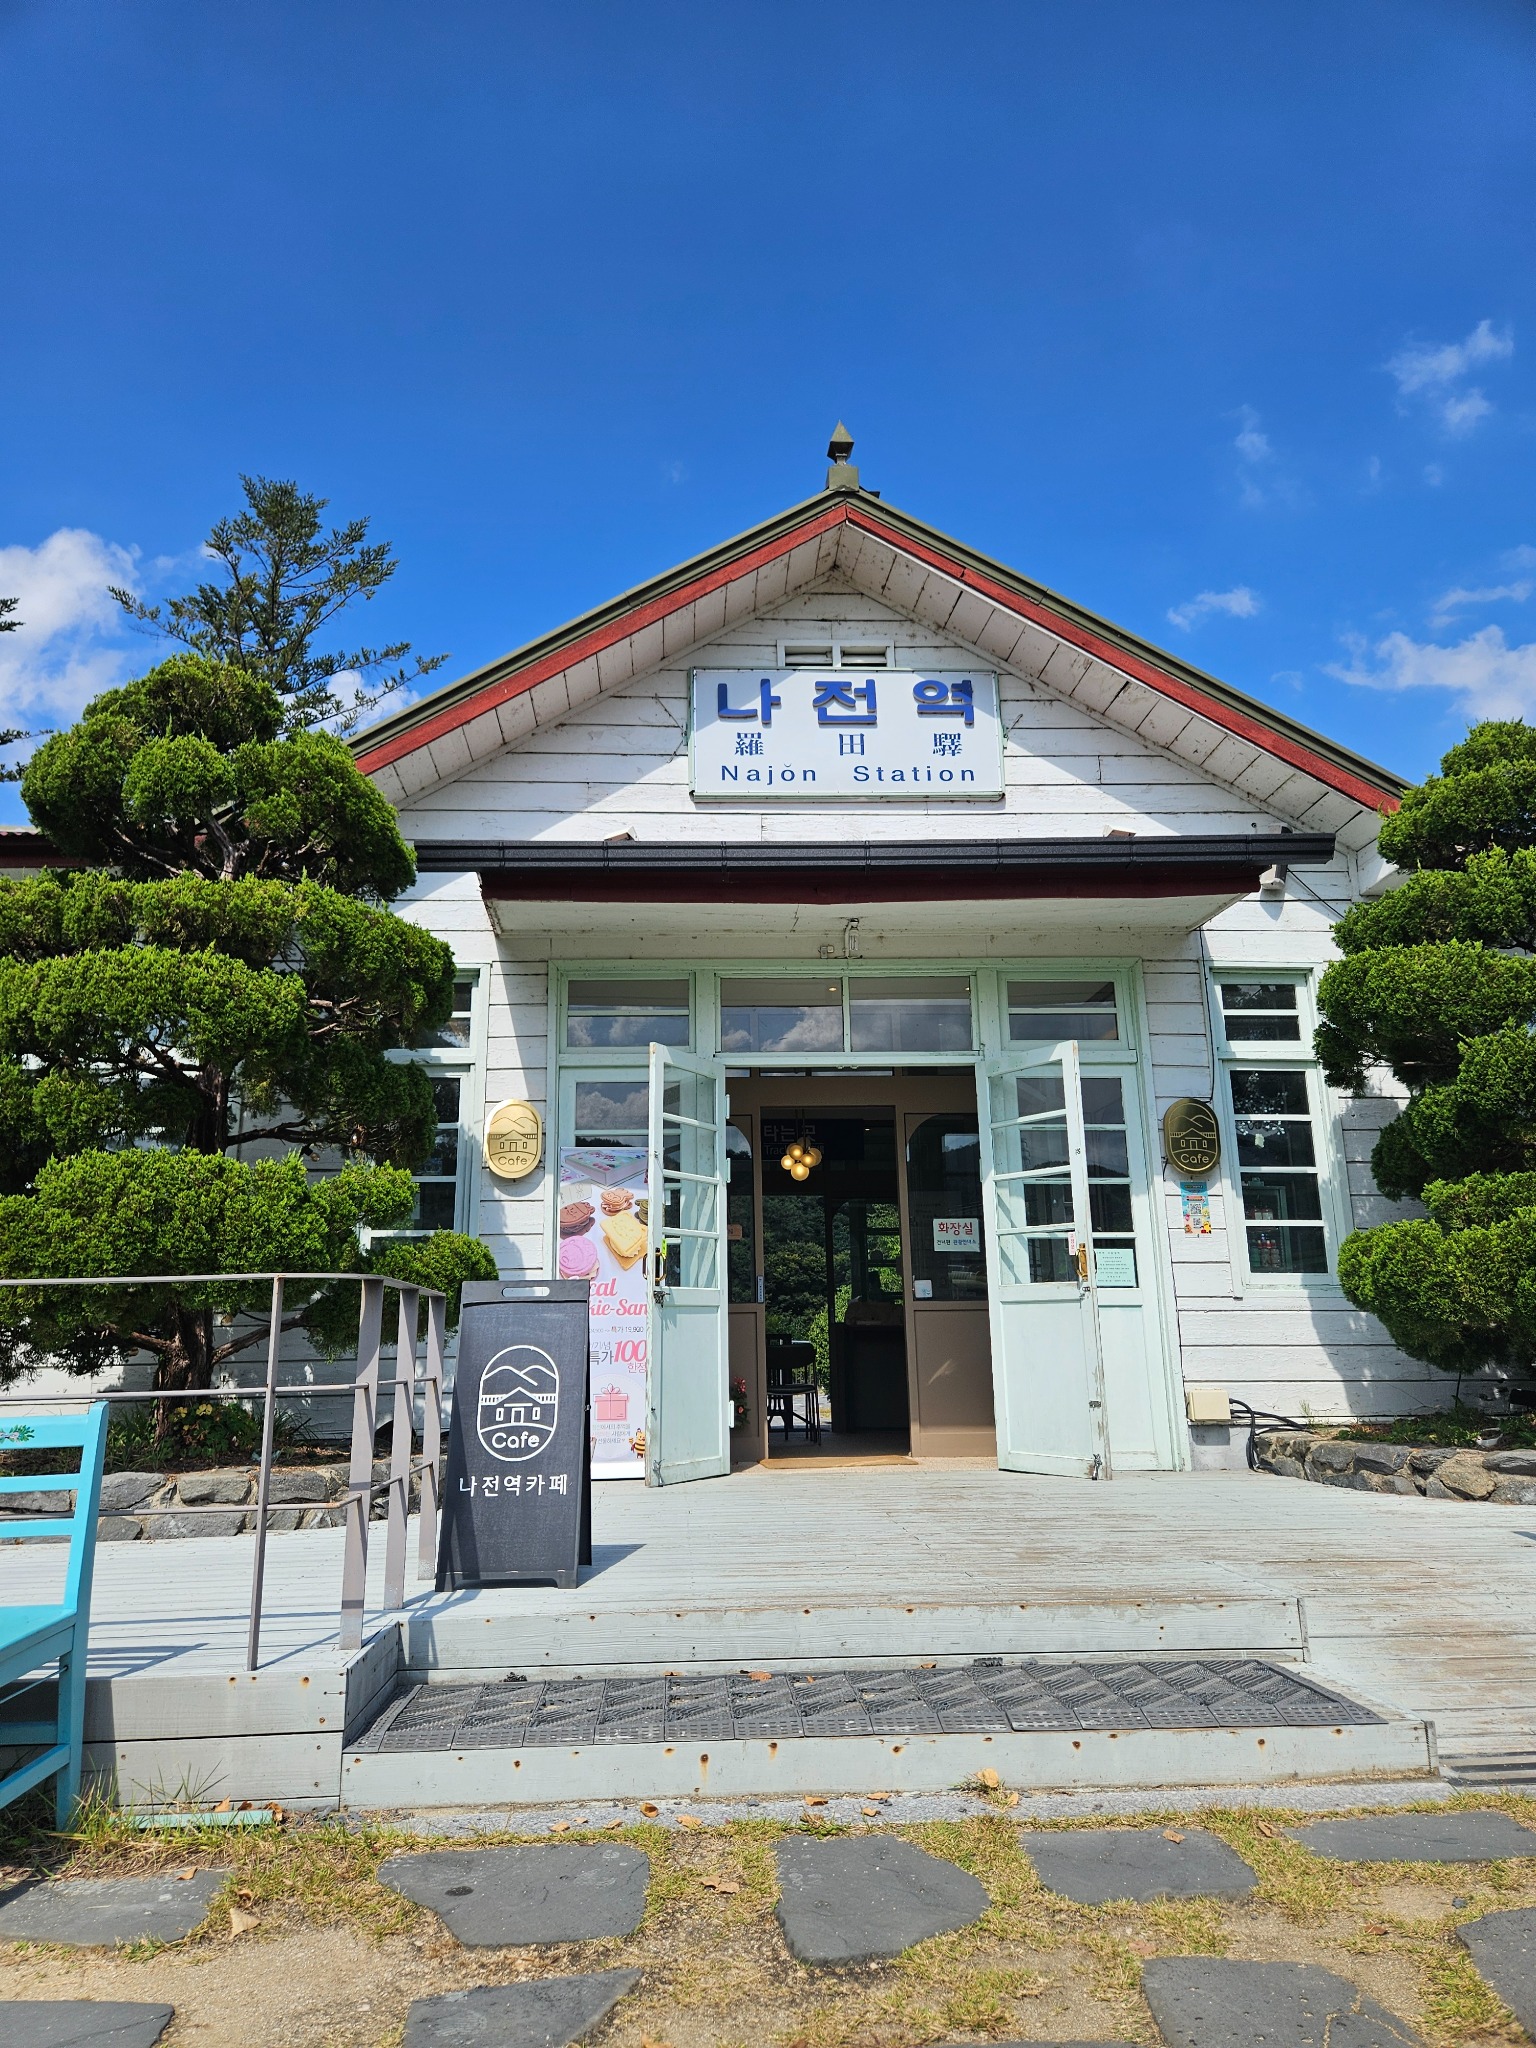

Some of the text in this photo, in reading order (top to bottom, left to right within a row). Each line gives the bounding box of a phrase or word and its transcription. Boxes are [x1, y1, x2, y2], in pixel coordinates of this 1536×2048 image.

[717, 678, 975, 727] 나전역
[735, 732, 962, 757] 羅田驛
[853, 765, 976, 782] Station
[498, 1156, 527, 1166] Cafe
[1180, 1153, 1209, 1165] Cafe
[938, 1222, 973, 1236] 화장실
[590, 1350, 614, 1365] 특가
[492, 1431, 540, 1449] Cafe
[458, 1474, 568, 1497] 나전역카페
